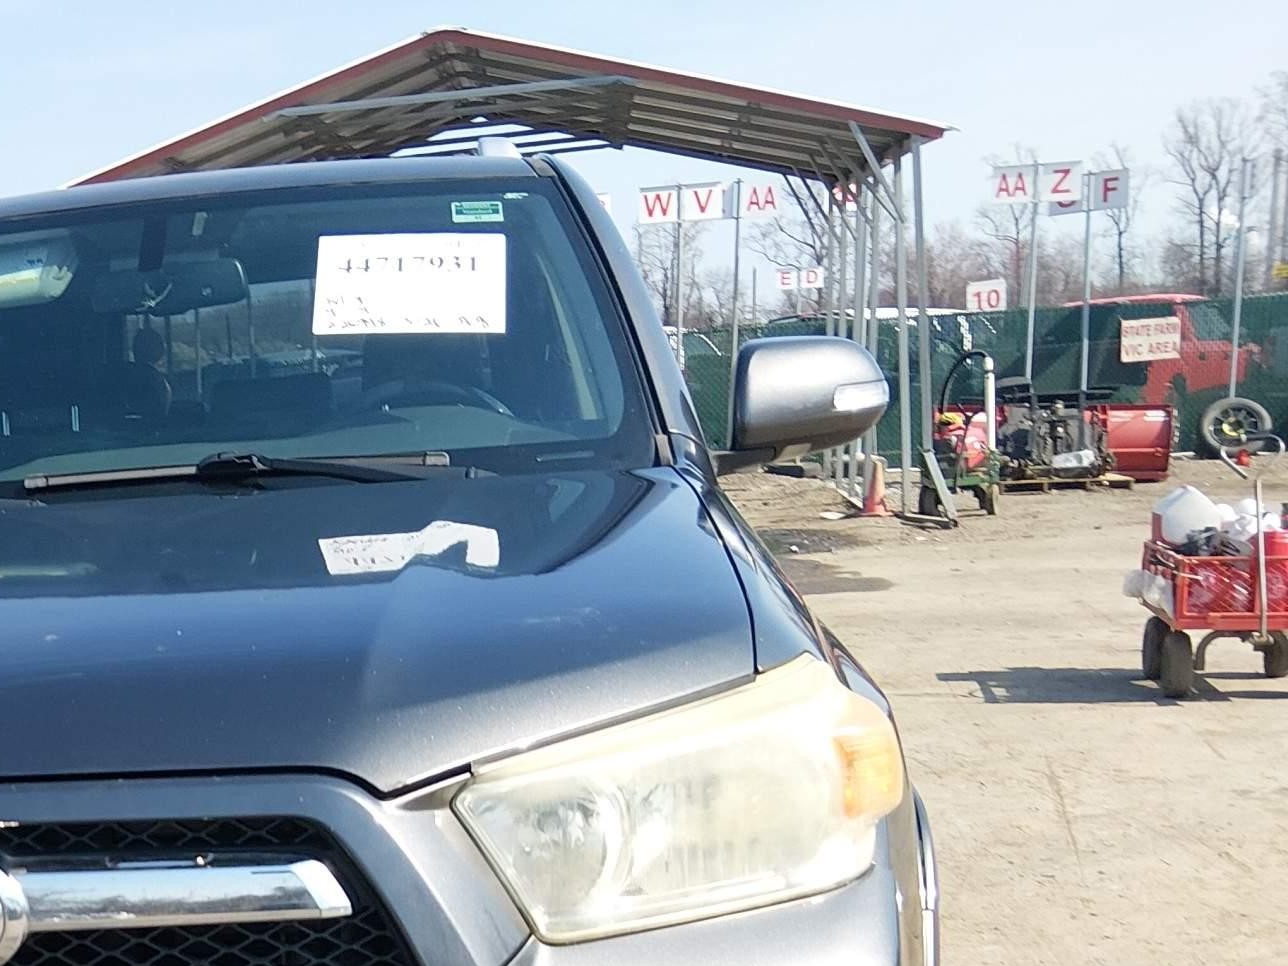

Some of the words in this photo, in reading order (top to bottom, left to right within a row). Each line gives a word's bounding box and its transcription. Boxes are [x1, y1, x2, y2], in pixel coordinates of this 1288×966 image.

[995, 172, 1028, 198] AA
[1050, 168, 1072, 194] Z
[1102, 176, 1120, 203] F
[643, 191, 672, 218] W
[693, 188, 714, 214] V
[746, 185, 777, 212] AA
[780, 271, 793, 286] E
[806, 269, 819, 284] D
[973, 289, 1001, 310] 10
